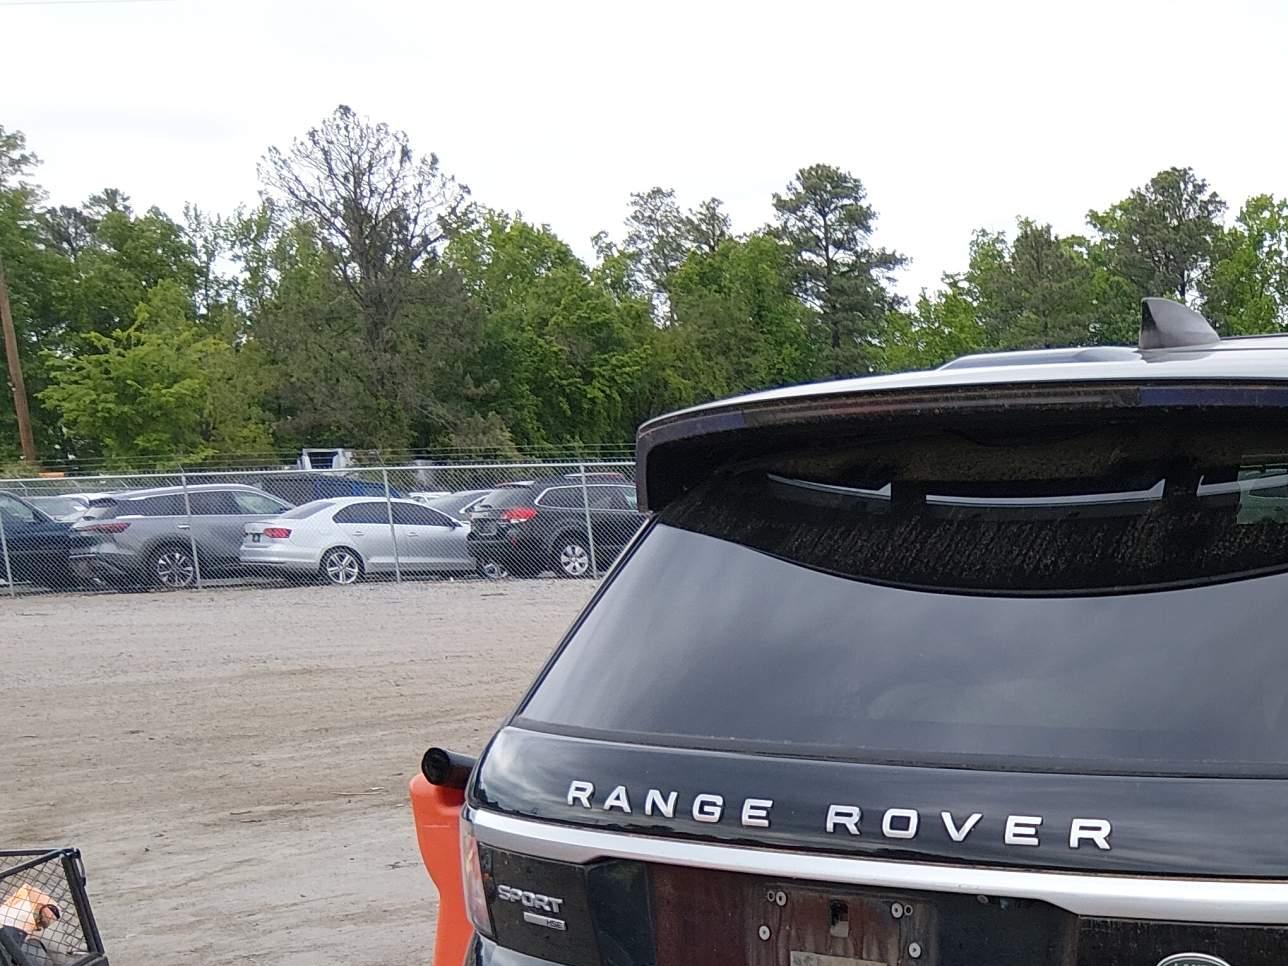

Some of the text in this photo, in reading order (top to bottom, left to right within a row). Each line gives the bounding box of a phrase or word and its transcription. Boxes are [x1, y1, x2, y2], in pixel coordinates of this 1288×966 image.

[567, 780, 1112, 850] RANGE ROVER
[497, 884, 563, 913] SPORT
